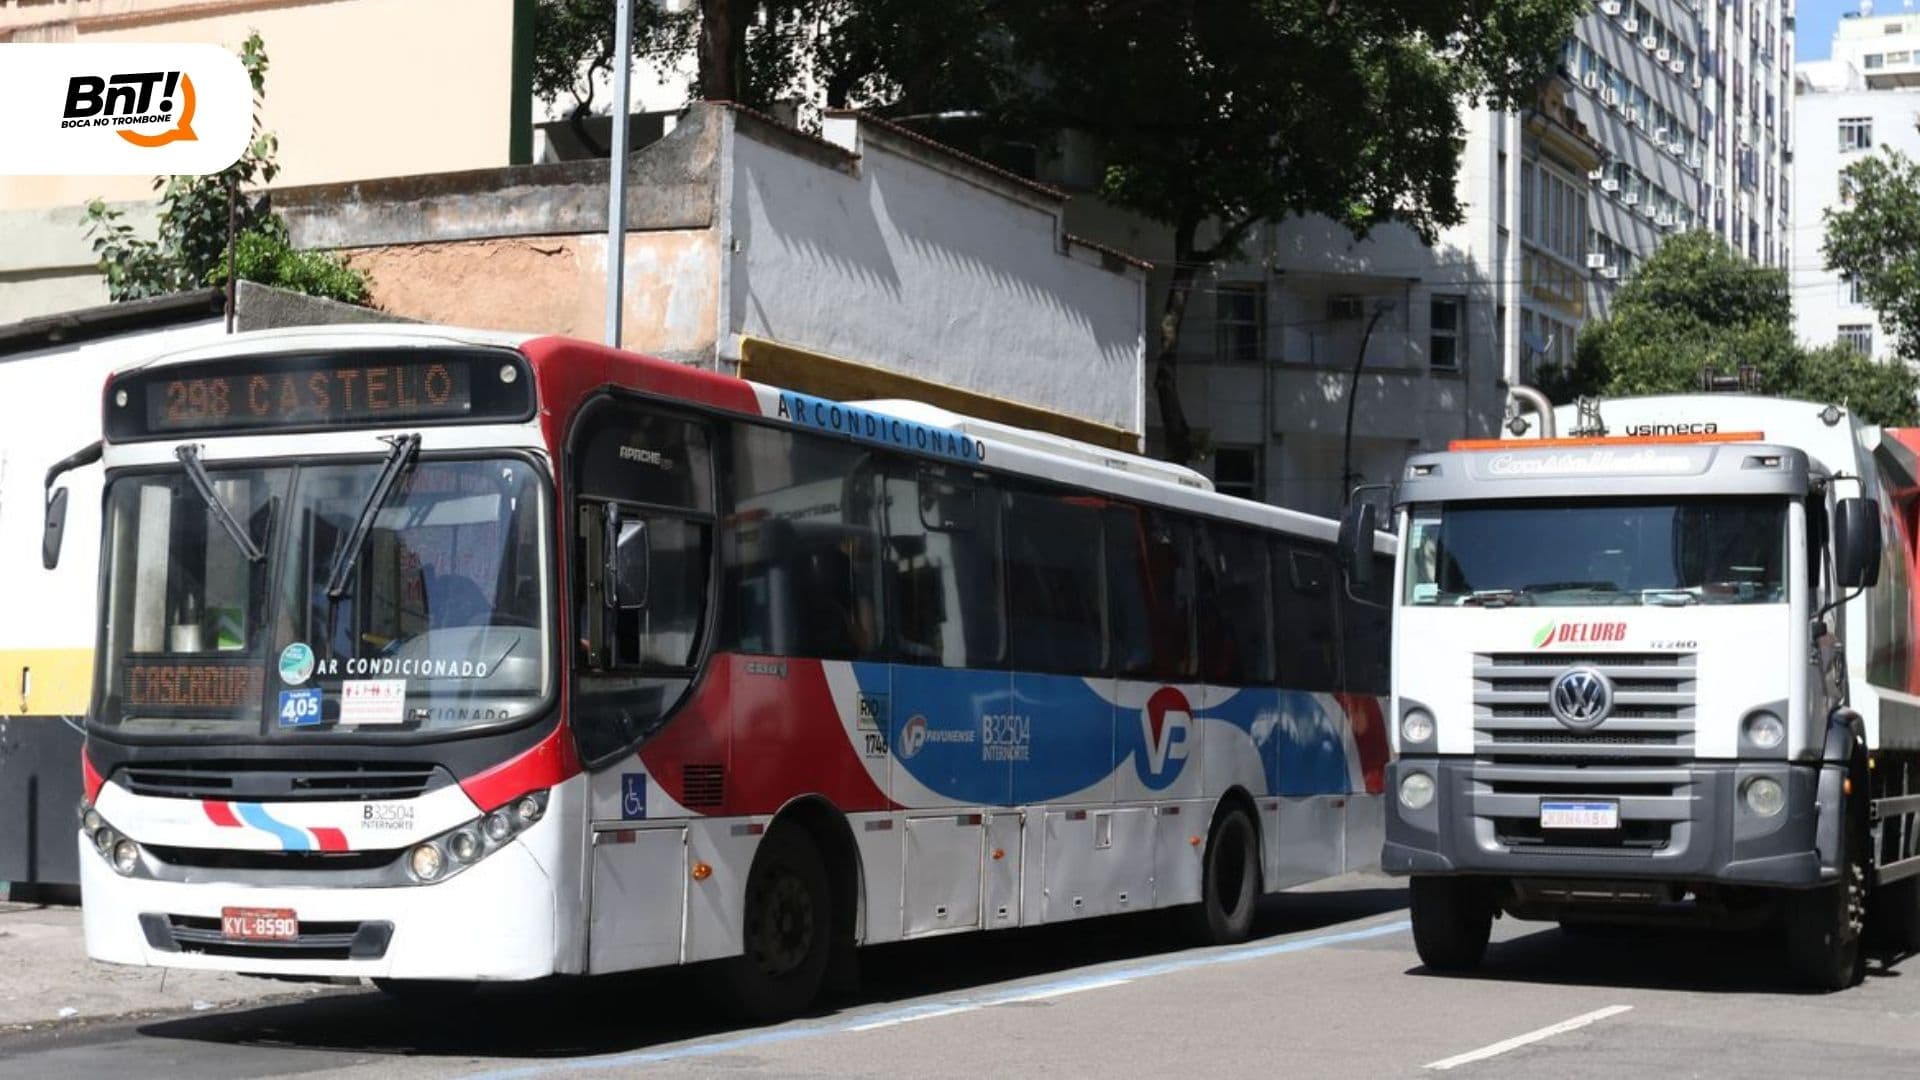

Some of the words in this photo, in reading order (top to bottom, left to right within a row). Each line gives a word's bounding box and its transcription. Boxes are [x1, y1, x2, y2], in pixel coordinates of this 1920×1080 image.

[167, 377, 231, 421] 298
[248, 363, 454, 417] CASTELO
[777, 393, 807, 423] AR
[815, 402, 986, 461] CONDICIONADO
[1625, 422, 1718, 436] usimeca
[1558, 623, 1628, 641] DELURB
[317, 658, 338, 675] AR
[346, 658, 487, 677] CONDICIONADO
[983, 715, 1030, 744] B32504
[363, 804, 414, 820] B32504
